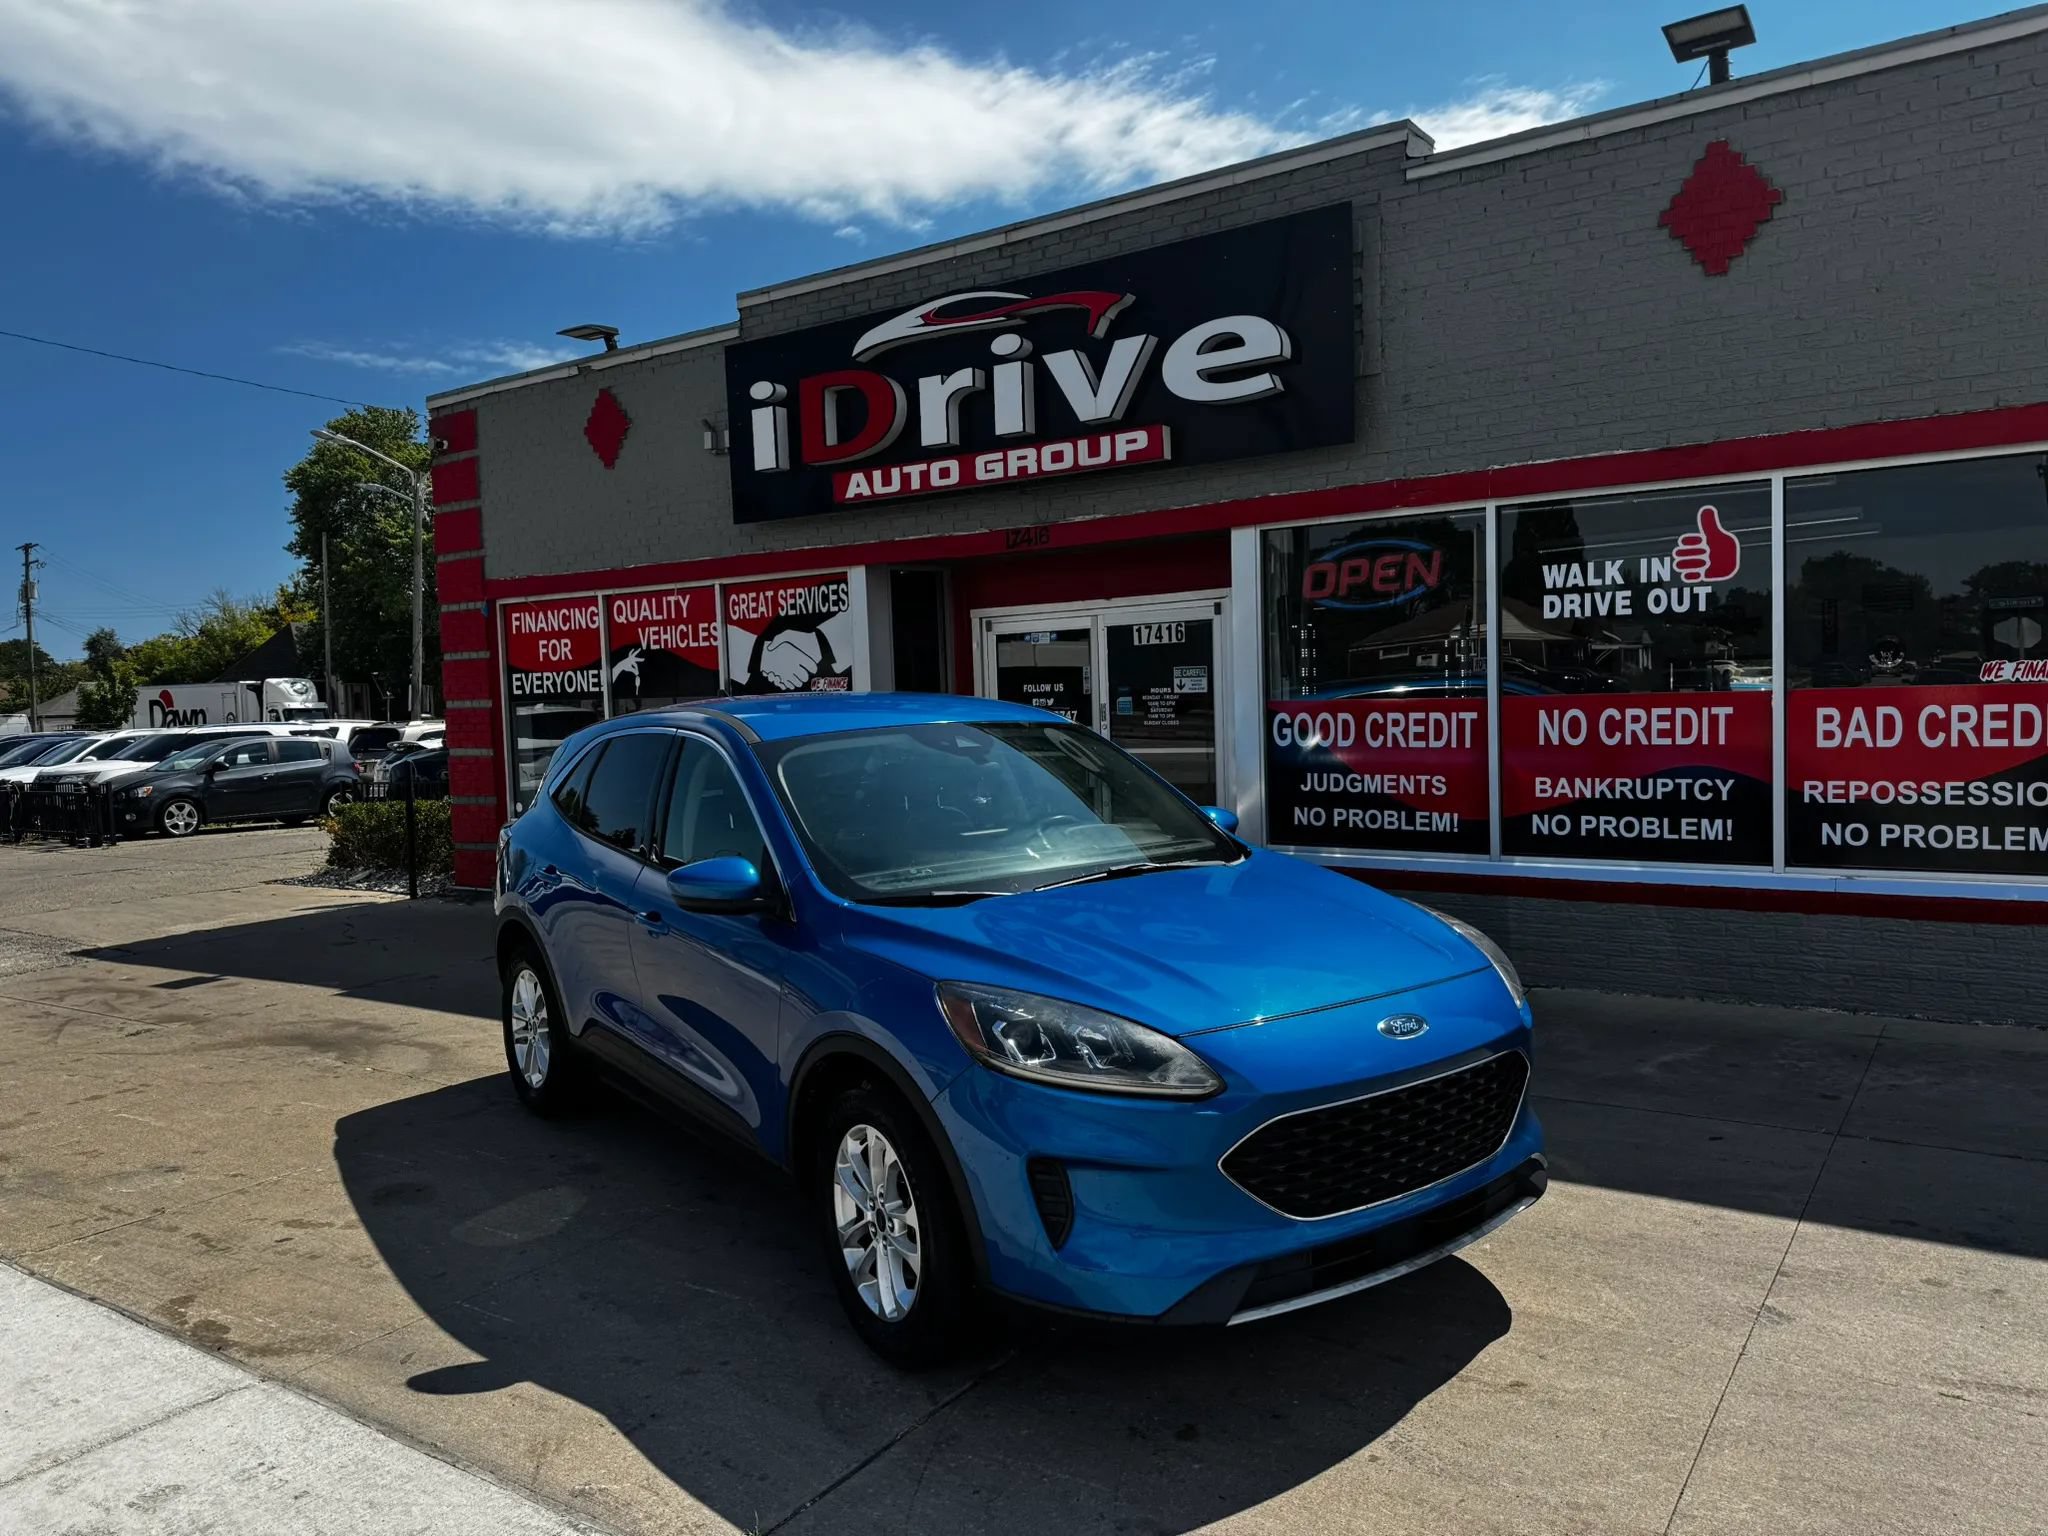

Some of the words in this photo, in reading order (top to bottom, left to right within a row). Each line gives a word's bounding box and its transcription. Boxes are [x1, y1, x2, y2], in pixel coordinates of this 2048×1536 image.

[749, 315, 1291, 472] iDrive
[845, 457, 959, 498] AUTO
[975, 430, 1149, 482] GROUP
[1302, 549, 1443, 601] OPEN
[1543, 559, 1624, 589] WALK
[1640, 556, 1672, 583] IN
[613, 594, 691, 624] QUALITY
[729, 592, 774, 620] GREAT
[777, 584, 849, 616] SERVICES
[1543, 590, 1632, 620] DRIVE
[1647, 586, 1712, 614] OUT
[512, 606, 599, 635] FINANCING
[1136, 623, 1184, 644] 17416
[538, 638, 573, 662] FOR
[638, 622, 719, 650] VEHICLES
[1175, 669, 1182, 677] BE
[1182, 669, 1206, 677] CAREFUL
[1981, 661, 2007, 679] WE
[2012, 659, 2048, 679] FINA
[1023, 683, 1051, 693] FOLLOW
[1053, 683, 1064, 692] US
[149, 700, 207, 728] Dawn
[1538, 709, 1588, 746] NO
[1598, 707, 1734, 746] CREDIT
[1816, 705, 1903, 749] BAD
[1917, 704, 2048, 749] CRED
[1272, 711, 1356, 749] GOOD
[1365, 711, 1478, 749] CREDIT
[1300, 772, 1448, 796] JUDGMENTS
[1535, 778, 1735, 802] BANKRUPTCY
[1293, 806, 1327, 827] NO
[1333, 810, 1459, 833] PROBLEM!
[1532, 815, 1572, 836] NO
[1580, 815, 1734, 842] PROBLEM!
[1821, 823, 1869, 847] NO
[1880, 824, 2048, 852] PROBLEM
[1390, 1018, 1419, 1034] Ford
